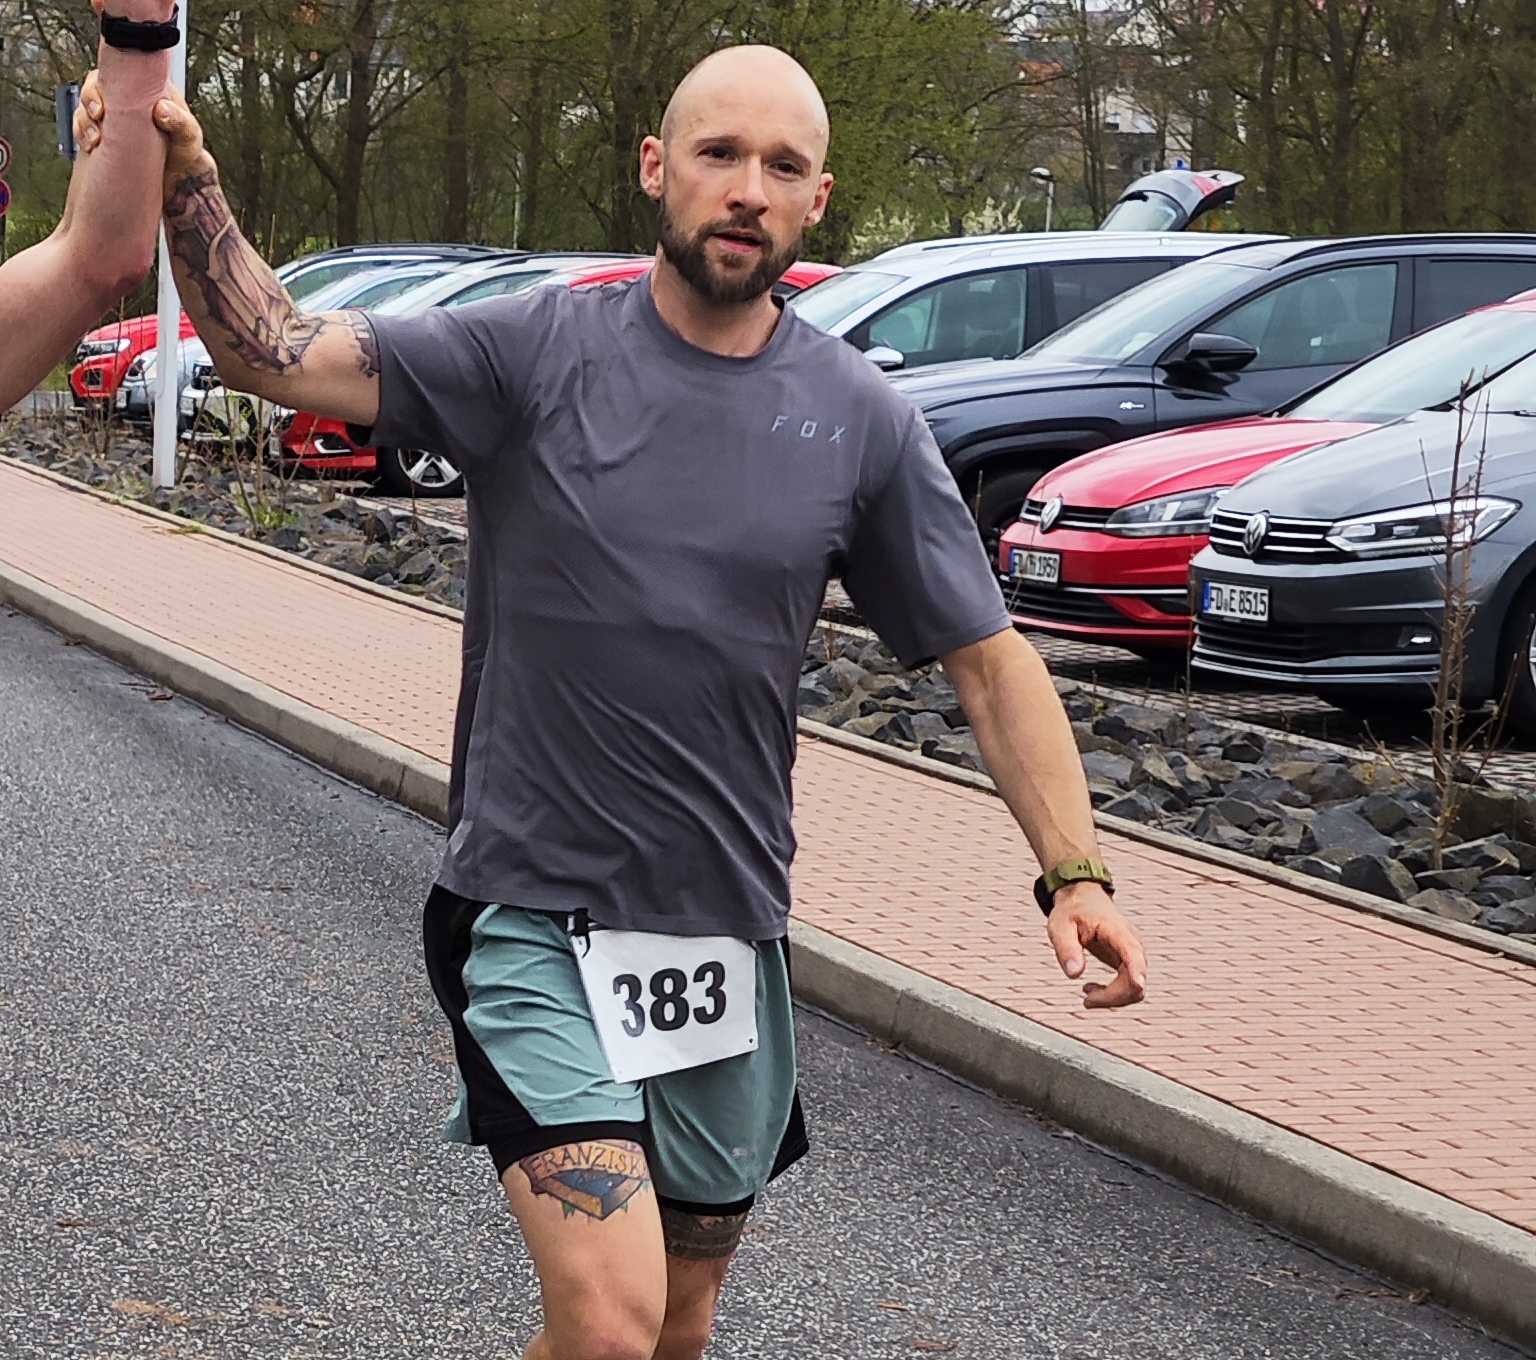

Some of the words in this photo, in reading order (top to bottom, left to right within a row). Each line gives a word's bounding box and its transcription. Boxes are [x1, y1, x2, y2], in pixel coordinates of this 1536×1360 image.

[771, 415, 846, 444] FOX
[1210, 586, 1224, 610] FD
[1229, 588, 1237, 613] E
[1239, 590, 1268, 616] 8515
[613, 961, 726, 1037] 383
[527, 1144, 647, 1176] FRANZISK
